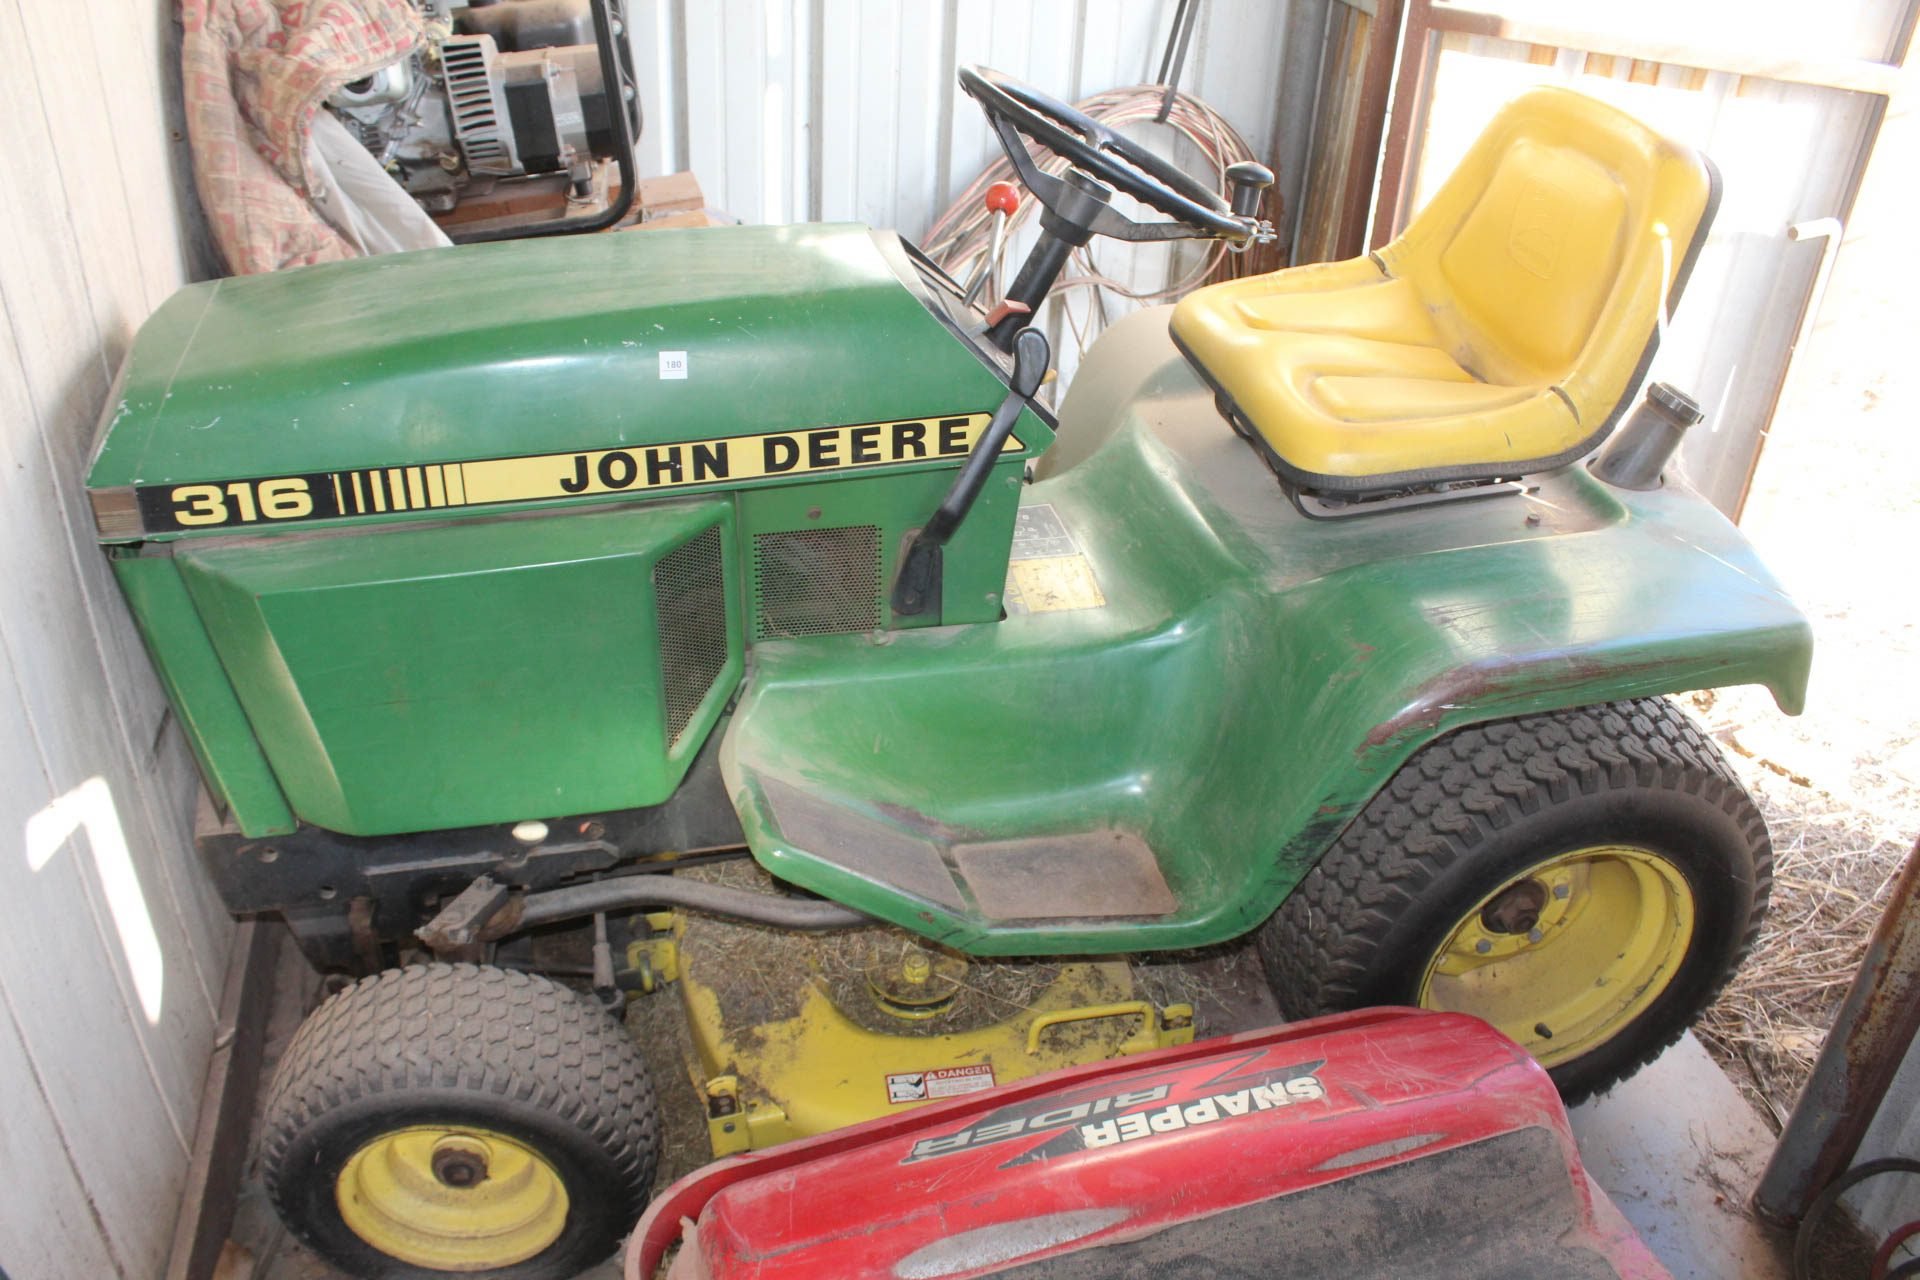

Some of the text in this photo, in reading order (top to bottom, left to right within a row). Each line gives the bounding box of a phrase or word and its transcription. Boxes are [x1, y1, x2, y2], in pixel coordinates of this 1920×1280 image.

[665, 360, 682, 369] 180
[560, 417, 971, 493] JOHN DEERE
[170, 477, 313, 526] 316
[938, 1065, 991, 1078] DANGER
[912, 1085, 1169, 1157] RIDER
[1081, 1075, 1325, 1149] SNAPPER
